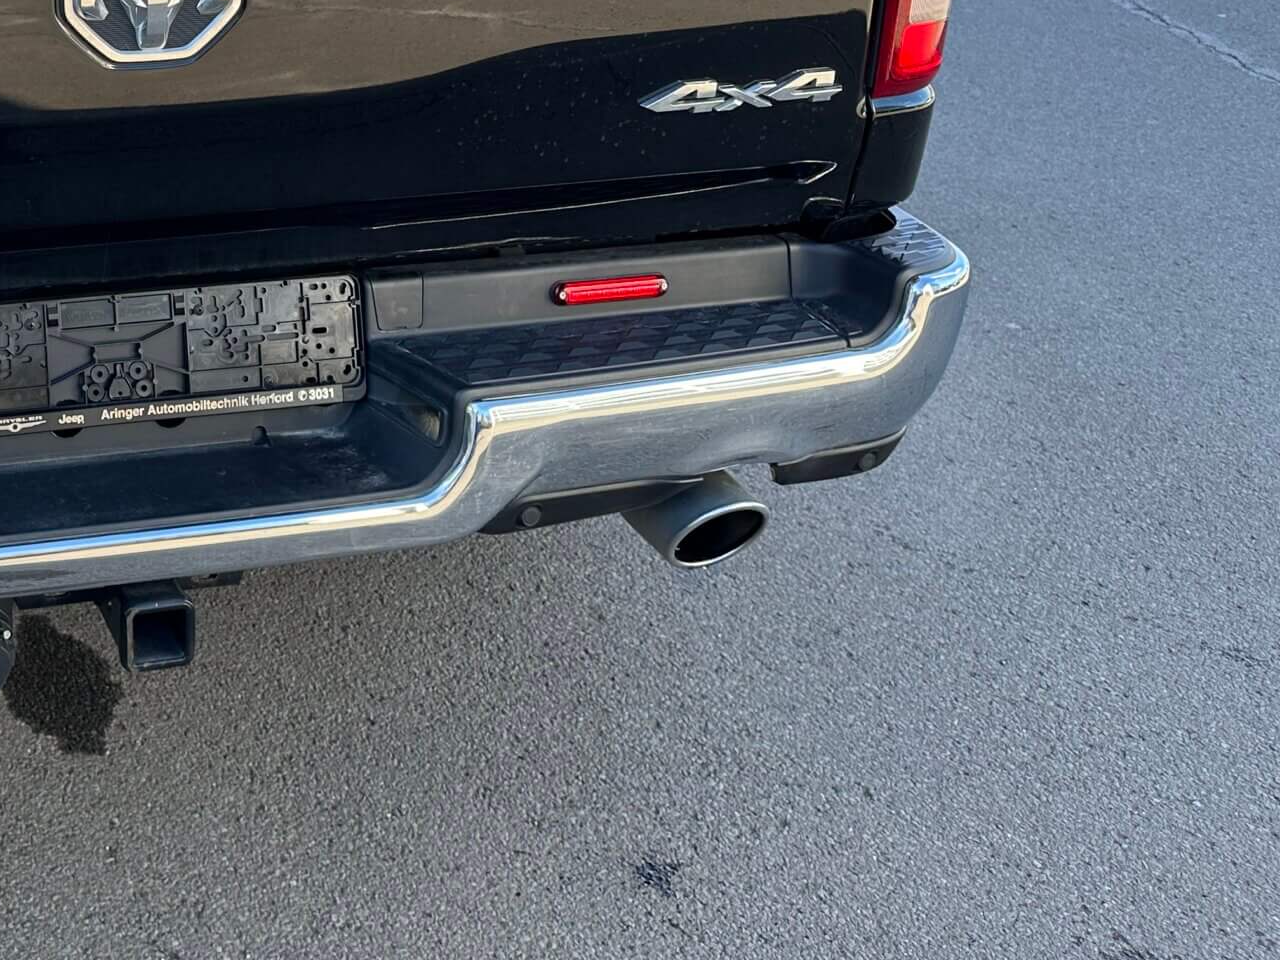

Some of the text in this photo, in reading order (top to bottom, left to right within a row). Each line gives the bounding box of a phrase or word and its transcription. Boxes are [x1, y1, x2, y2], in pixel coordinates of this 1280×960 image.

[101, 387, 335, 421] Aringer Automobiltechnik Herford 3031
[58, 414, 85, 425] Jeep
